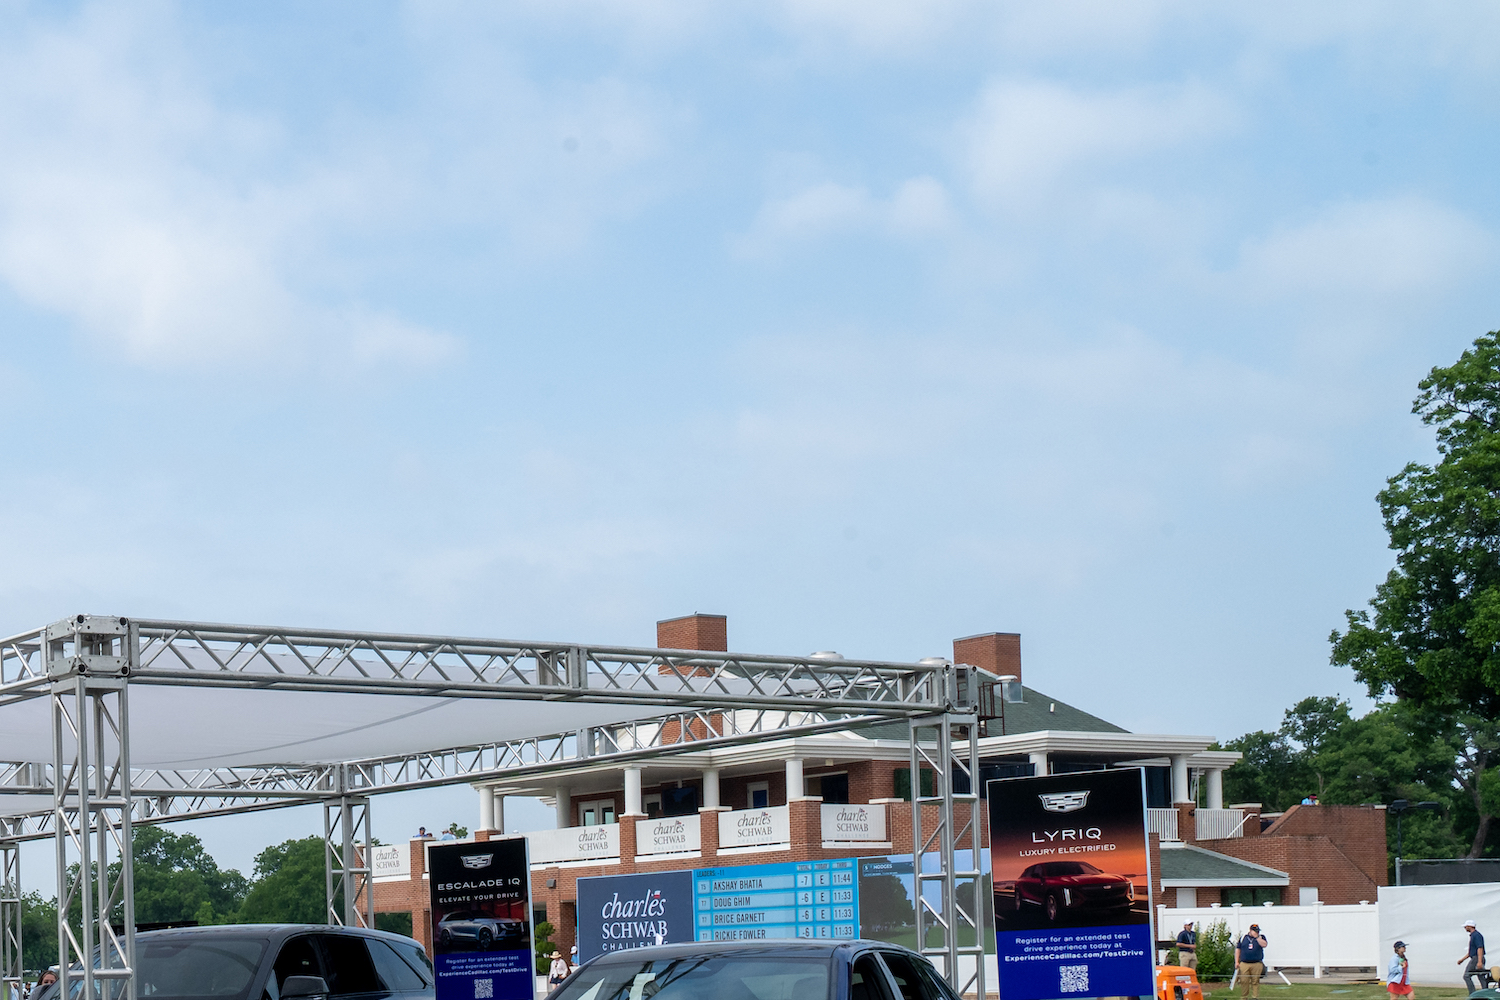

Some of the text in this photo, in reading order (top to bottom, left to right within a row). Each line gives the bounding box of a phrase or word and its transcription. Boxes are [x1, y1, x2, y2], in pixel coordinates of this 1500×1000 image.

[737, 811, 772, 828] charles
[836, 807, 868, 822] charles
[653, 820, 685, 836] charles
[737, 826, 773, 838] SCHWAB
[836, 822, 869, 832] SCHWAB
[578, 828, 607, 842] charles
[653, 834, 686, 846] SCHWAB
[1032, 827, 1102, 843] LYRIQ
[578, 841, 609, 851] SCHWAB
[1019, 844, 1117, 857] LUXURY ELECTRIFIED
[375, 848, 400, 861] charles
[375, 860, 401, 870] SCHWAB
[437, 877, 521, 891] ESCALADE IQ
[713, 881, 737, 891] AKSHAY
[739, 879, 763, 889] BHATIA
[801, 876, 808, 886] -7
[833, 873, 851, 883] 11:44
[439, 895, 471, 904] ELEVATE
[474, 893, 494, 901] YOUR
[601, 889, 667, 919] charles
[714, 897, 732, 907] DOUG
[733, 896, 751, 906] GHIM
[801, 893, 809, 902] -6
[833, 891, 851, 901] 11:33
[714, 914, 735, 924] BRICE
[736, 912, 765, 923] GARNETT
[802, 910, 810, 920] -6
[834, 908, 852, 918] 11:33
[602, 920, 668, 940] SCHWAB
[715, 930, 737, 940] RICKIE
[739, 929, 766, 939] FOWLER
[802, 927, 810, 937] -6
[835, 926, 853, 936] 11:33
[1015, 937, 1048, 945] Register
[1075, 934, 1112, 942] extended
[1045, 944, 1087, 952] experience
[1090, 942, 1111, 950] today
[446, 957, 467, 965] Register
[1005, 950, 1144, 962] ExperienceCadillac.com/TestDrive
[439, 968, 528, 977] ExperienceCadillac.com/TestDrive
